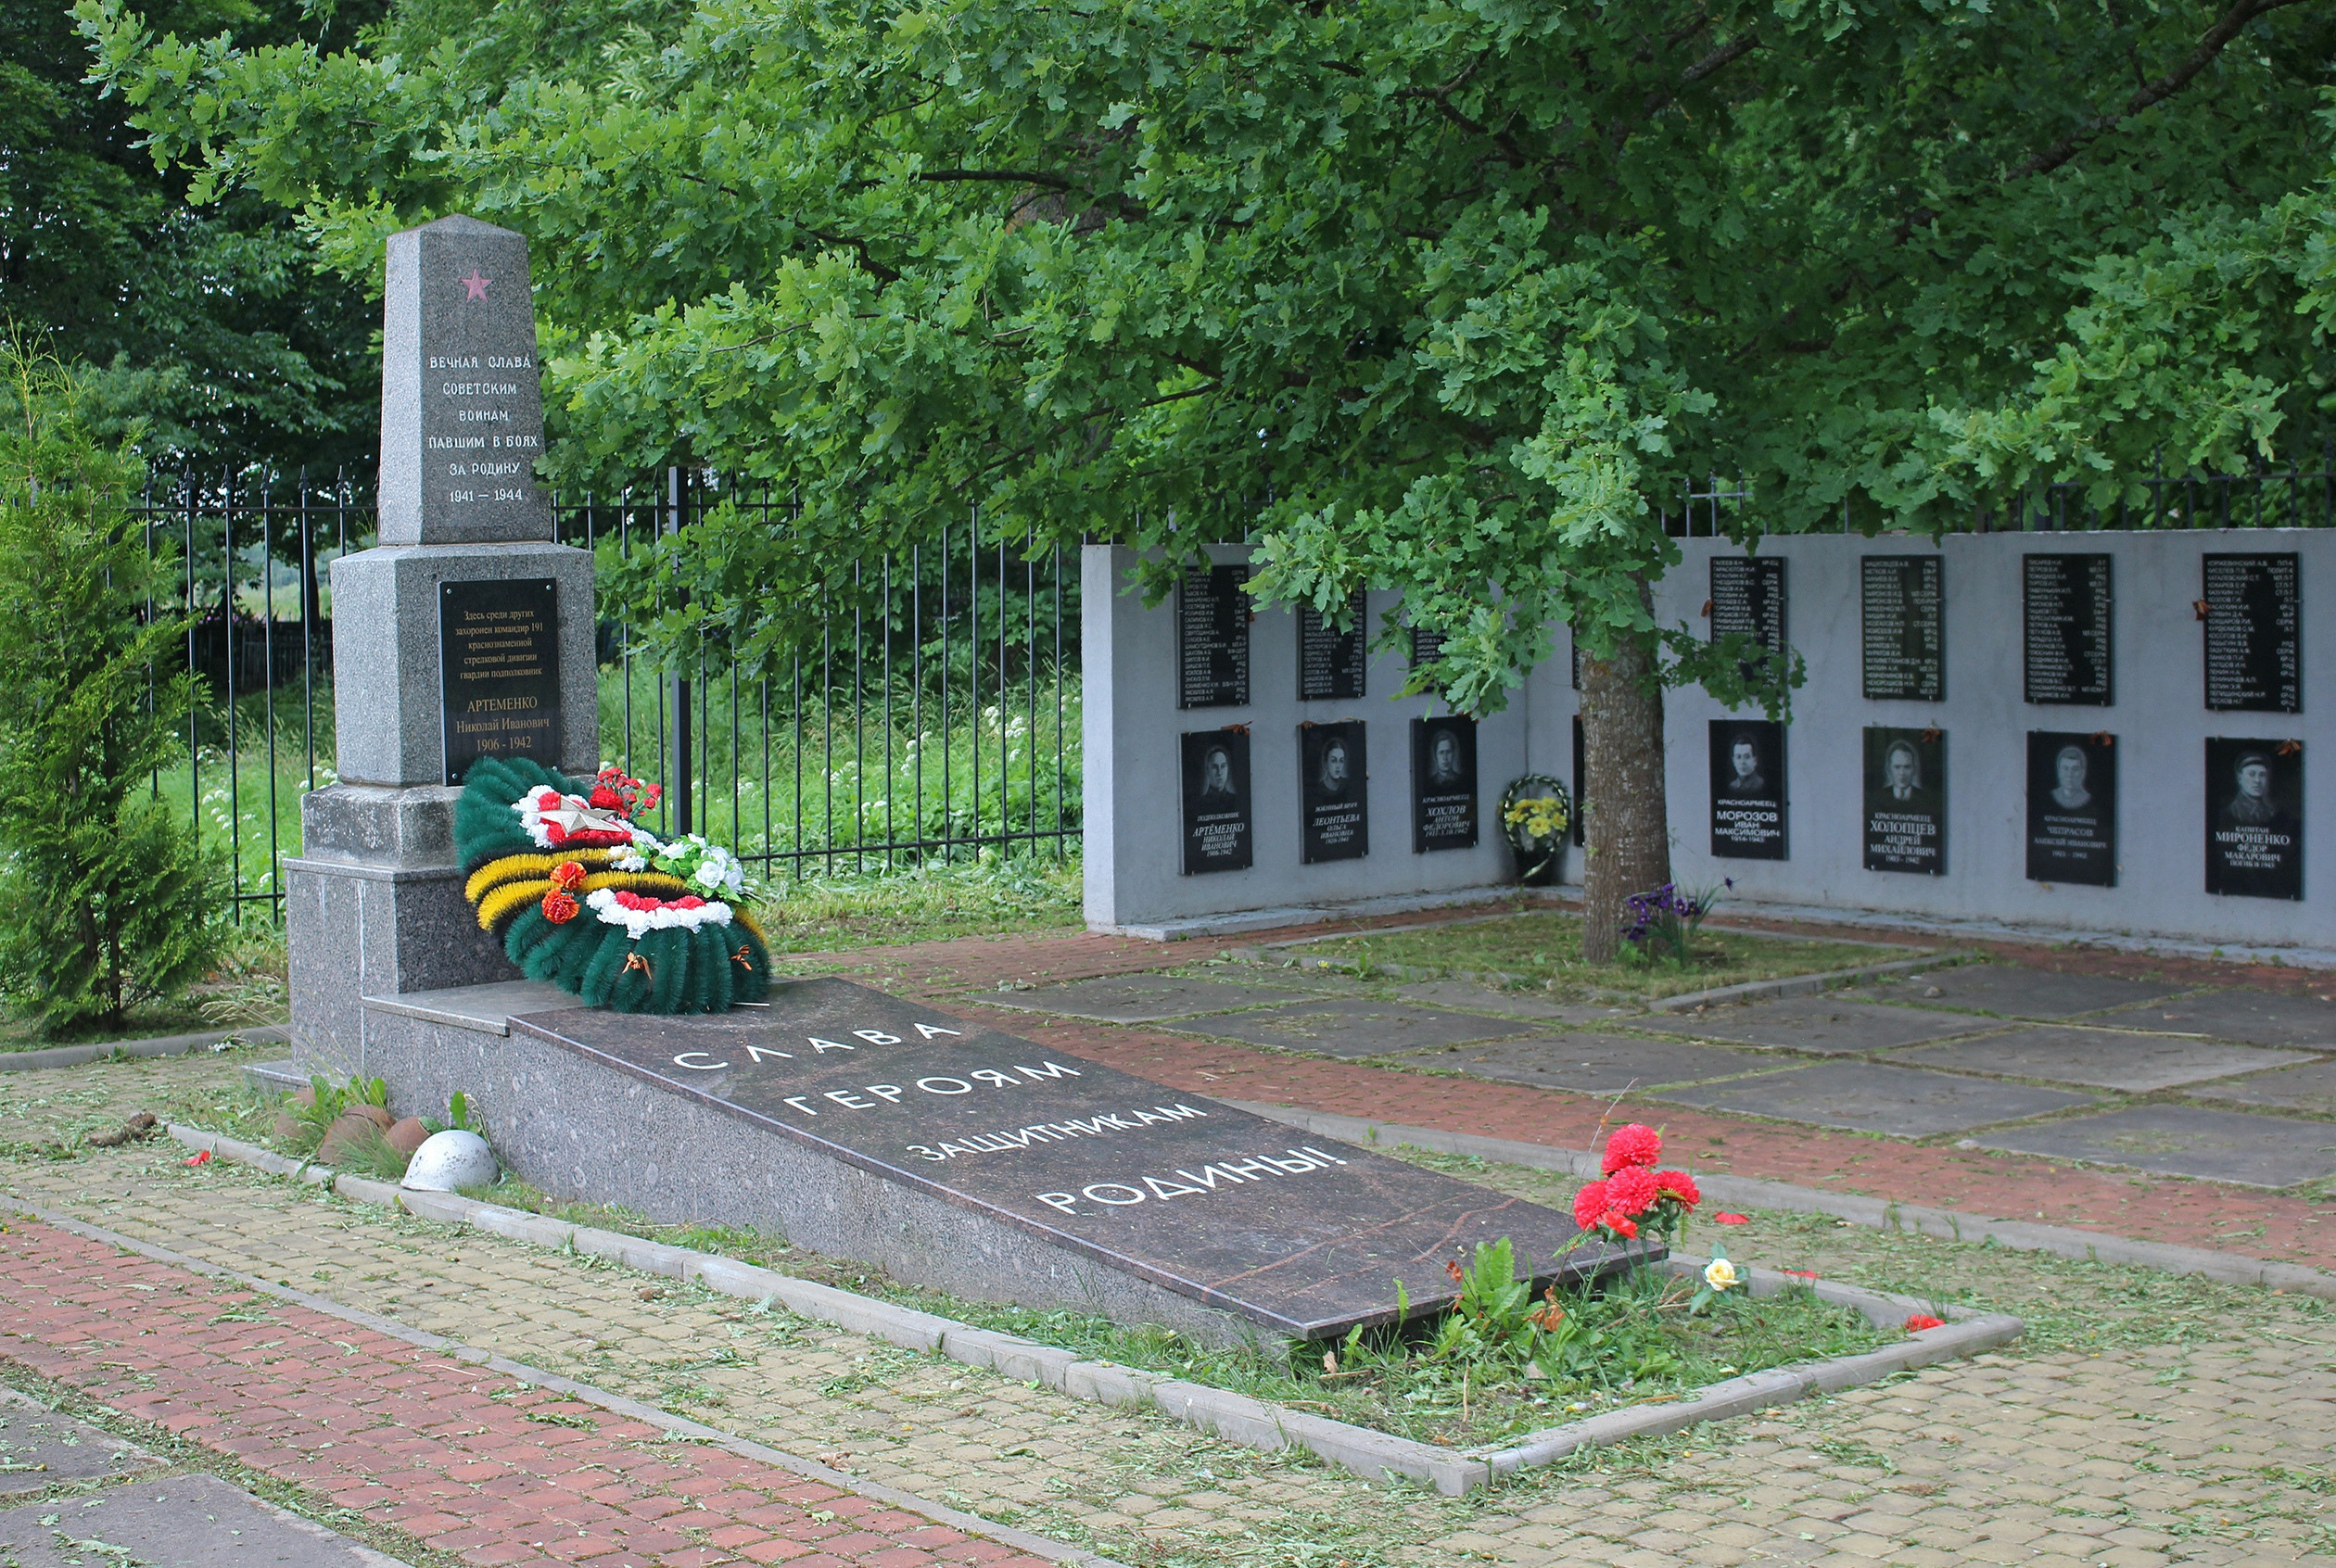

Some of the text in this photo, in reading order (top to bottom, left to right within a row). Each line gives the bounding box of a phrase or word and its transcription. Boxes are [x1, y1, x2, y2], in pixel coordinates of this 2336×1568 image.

[430, 356, 531, 368] ВЕЧНАЯ СЛАВА
[443, 383, 516, 395] СОВЕТСКИМ
[459, 410, 508, 421] ВОИНАМ
[429, 436, 538, 449] ПАВШИМ В БОЯХ
[450, 462, 520, 476] ЗА РОДИНУ
[450, 489, 474, 502] 1941
[494, 488, 523, 500] 1944
[463, 611, 534, 621] Здесь среди других
[455, 623, 543, 637] захоронен командир 191
[468, 638, 532, 651] краснознаменной
[463, 652, 537, 666] стрелковой дивизии
[460, 668, 542, 681] гвардии подполковник
[467, 696, 538, 713] АРТЕМЕНКО
[456, 717, 549, 733] Николай Иванович
[476, 738, 500, 752] 1906
[510, 736, 532, 749] 1942
[1718, 799, 1776, 808] КРАСНОАРМЕЕЦ
[1426, 805, 1466, 816] ХОХЛОВ
[1717, 811, 1778, 822] МОРОЗОВ
[1313, 814, 1360, 827] ЛЕОНТЬЕВА
[1874, 812, 1932, 823] КРАСНОАРМЕЕЦ
[1715, 828, 1780, 837] МАКСИМОВИЧ
[1870, 820, 1936, 836] ХОЛОПЦЕВ
[2047, 826, 2093, 837] ЧЕПРАСОВ
[1885, 835, 1922, 846] АНДРЕЙ
[2215, 831, 2291, 845] МИРОНЕНКО
[1870, 843, 1936, 856] МИХАЙЛОВИЧ
[2225, 851, 2281, 862] МАКАРОВИЧ
[673, 1020, 962, 1071] СЛАВА
[782, 1059, 1082, 1116] ГЕРОЯМ
[906, 1101, 1208, 1162] ЗАЩИТНИКАМ
[1035, 1145, 1348, 1216] РОДИНЫ!
